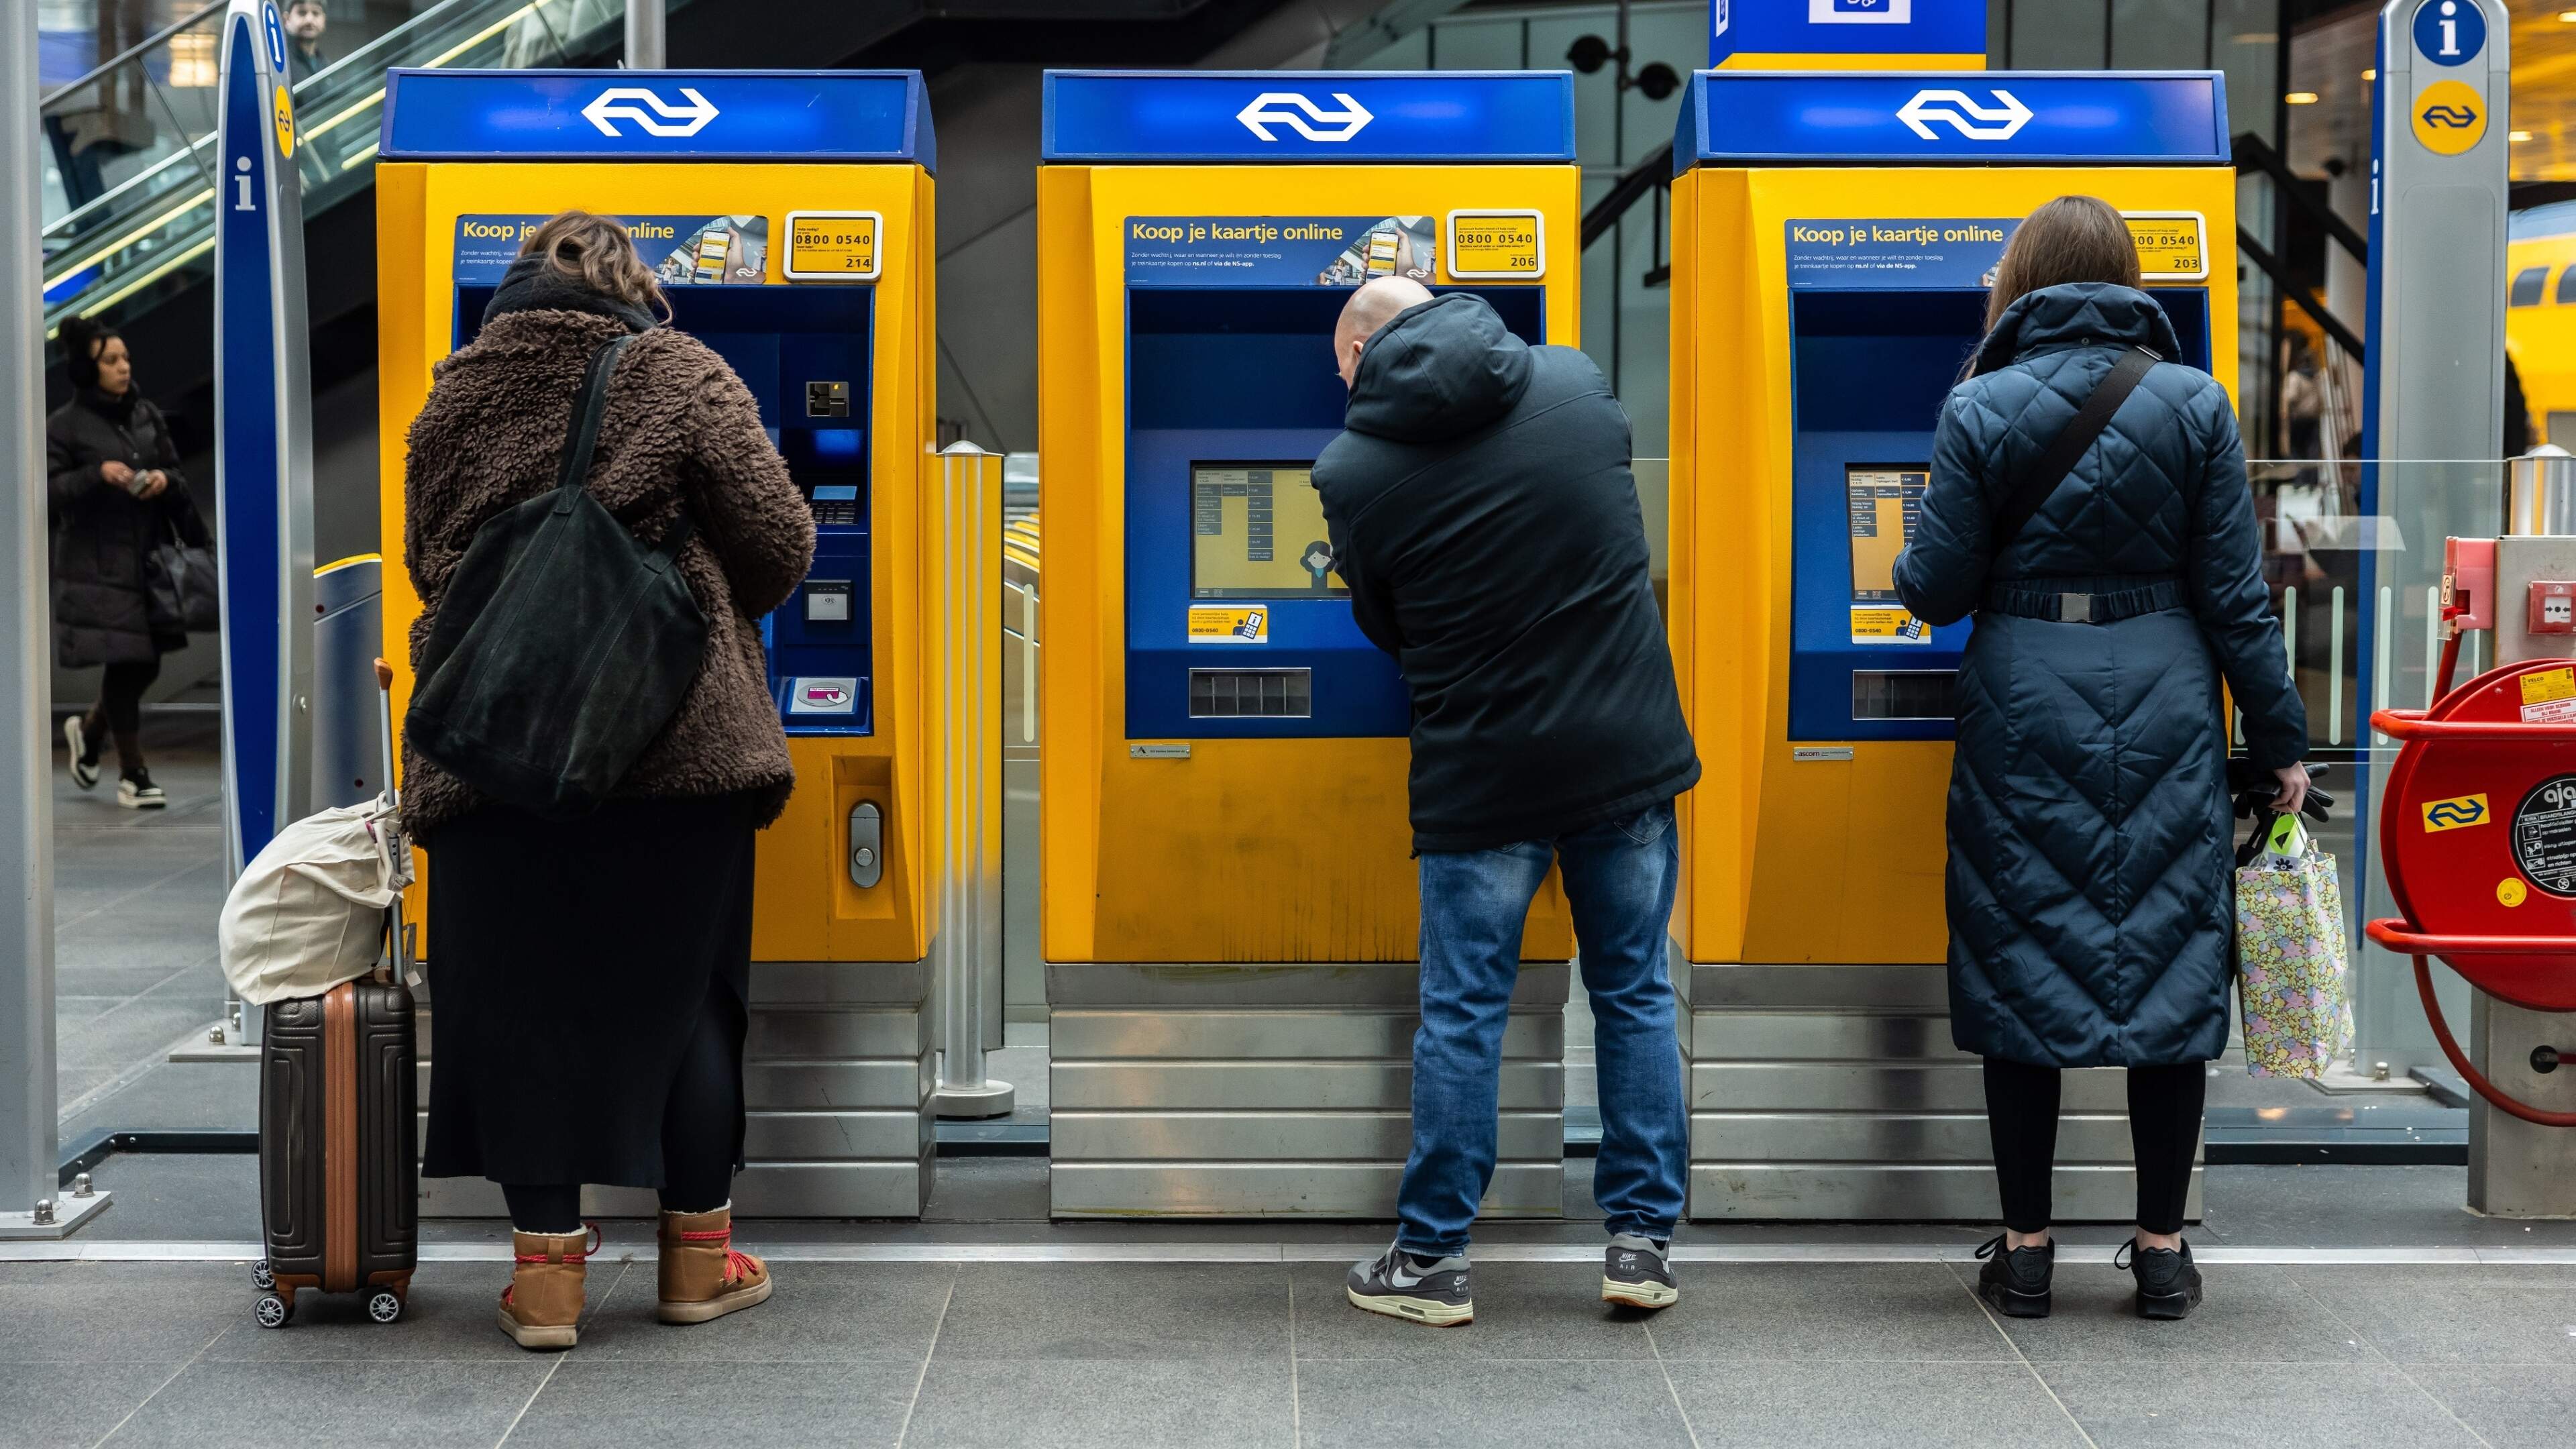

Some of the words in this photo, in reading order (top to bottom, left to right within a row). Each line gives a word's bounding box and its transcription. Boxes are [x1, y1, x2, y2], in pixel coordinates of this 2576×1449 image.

[235, 156, 256, 211] i
[464, 222, 515, 241] Koop
[518, 221, 537, 241] je
[1133, 223, 1183, 242] Koop
[1188, 223, 1205, 243] je
[1212, 223, 1277, 243] kaartje
[1283, 223, 1342, 239] online
[1794, 226, 1844, 246] Koop
[1849, 225, 1866, 246] je
[1873, 225, 1938, 246] kaartje
[1944, 225, 2003, 241] online
[796, 235, 829, 244] 0800
[836, 235, 870, 244] 0540
[1458, 234, 1491, 243] 0800
[1499, 234, 1532, 243] 0540
[2133, 235, 2154, 245] 00
[2160, 235, 2194, 245] 0540
[845, 258, 870, 268] 214
[1511, 257, 1535, 266] 206
[2174, 259, 2198, 268] 203
